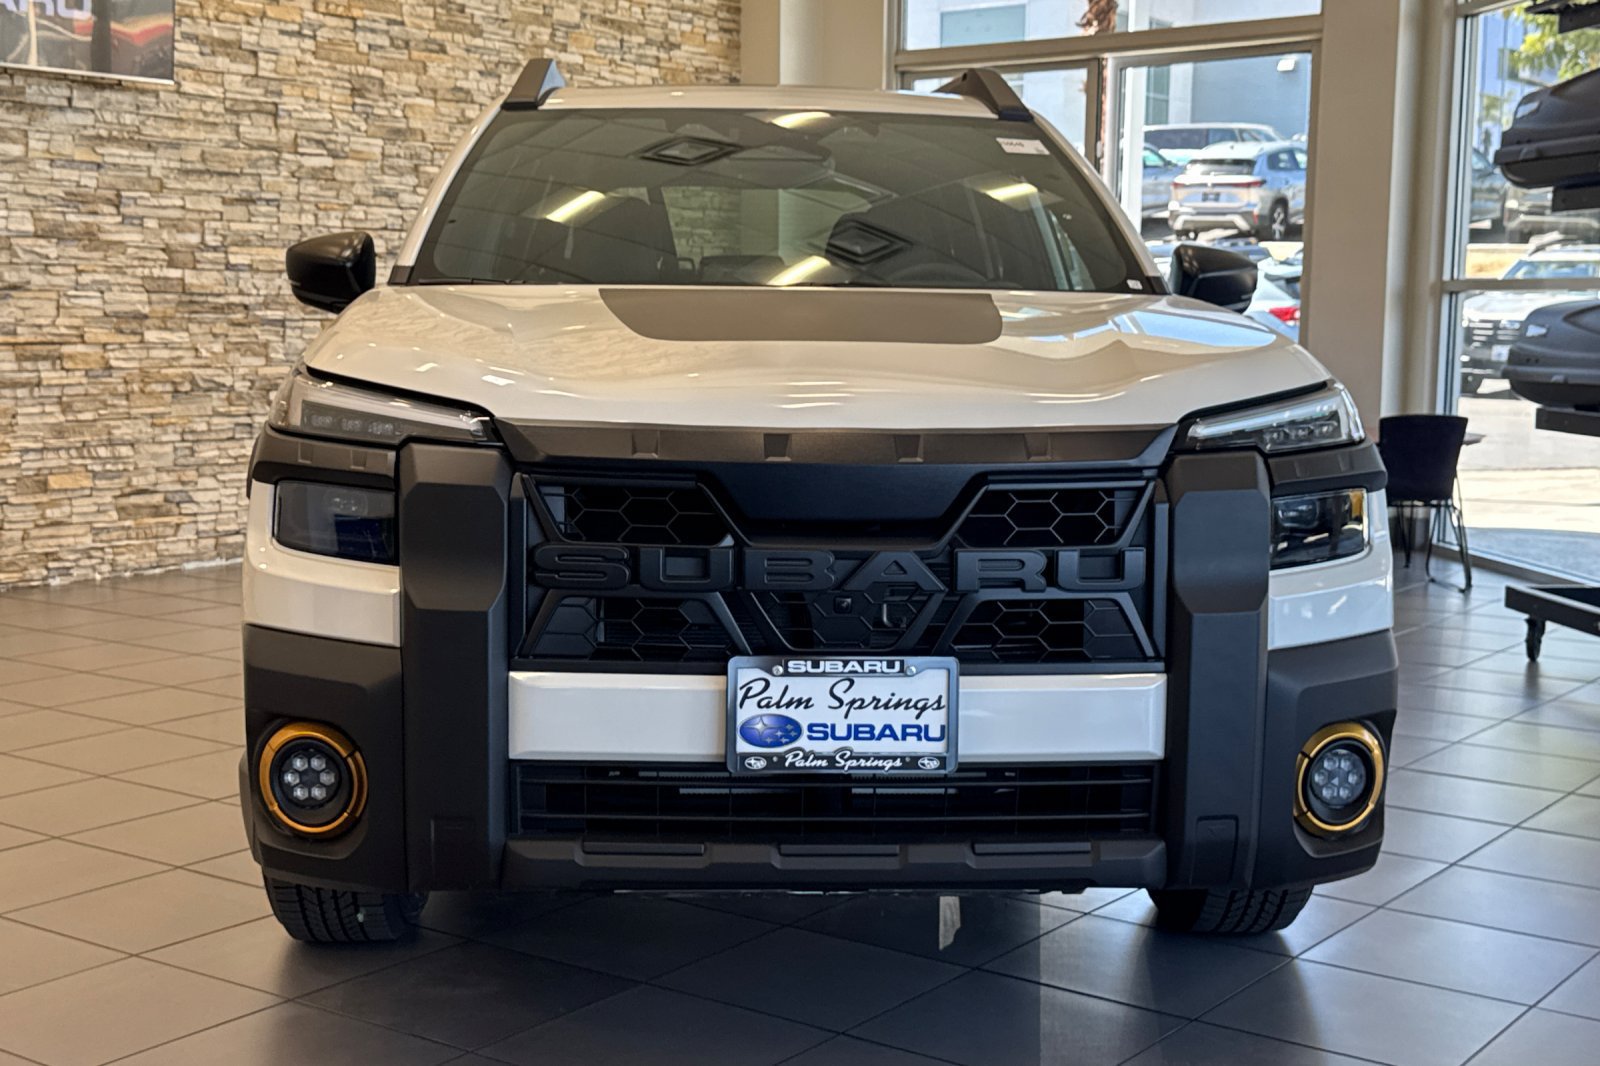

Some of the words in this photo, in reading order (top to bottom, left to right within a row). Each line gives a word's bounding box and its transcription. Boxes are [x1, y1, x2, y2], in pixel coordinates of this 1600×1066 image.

[534, 544, 1147, 592] SUBARU
[787, 660, 900, 674] SUBARU
[738, 677, 815, 710] Palm
[827, 677, 946, 720] Springs
[806, 722, 946, 742] SUBARU
[784, 750, 829, 768] Palm
[834, 750, 903, 773] Springs
